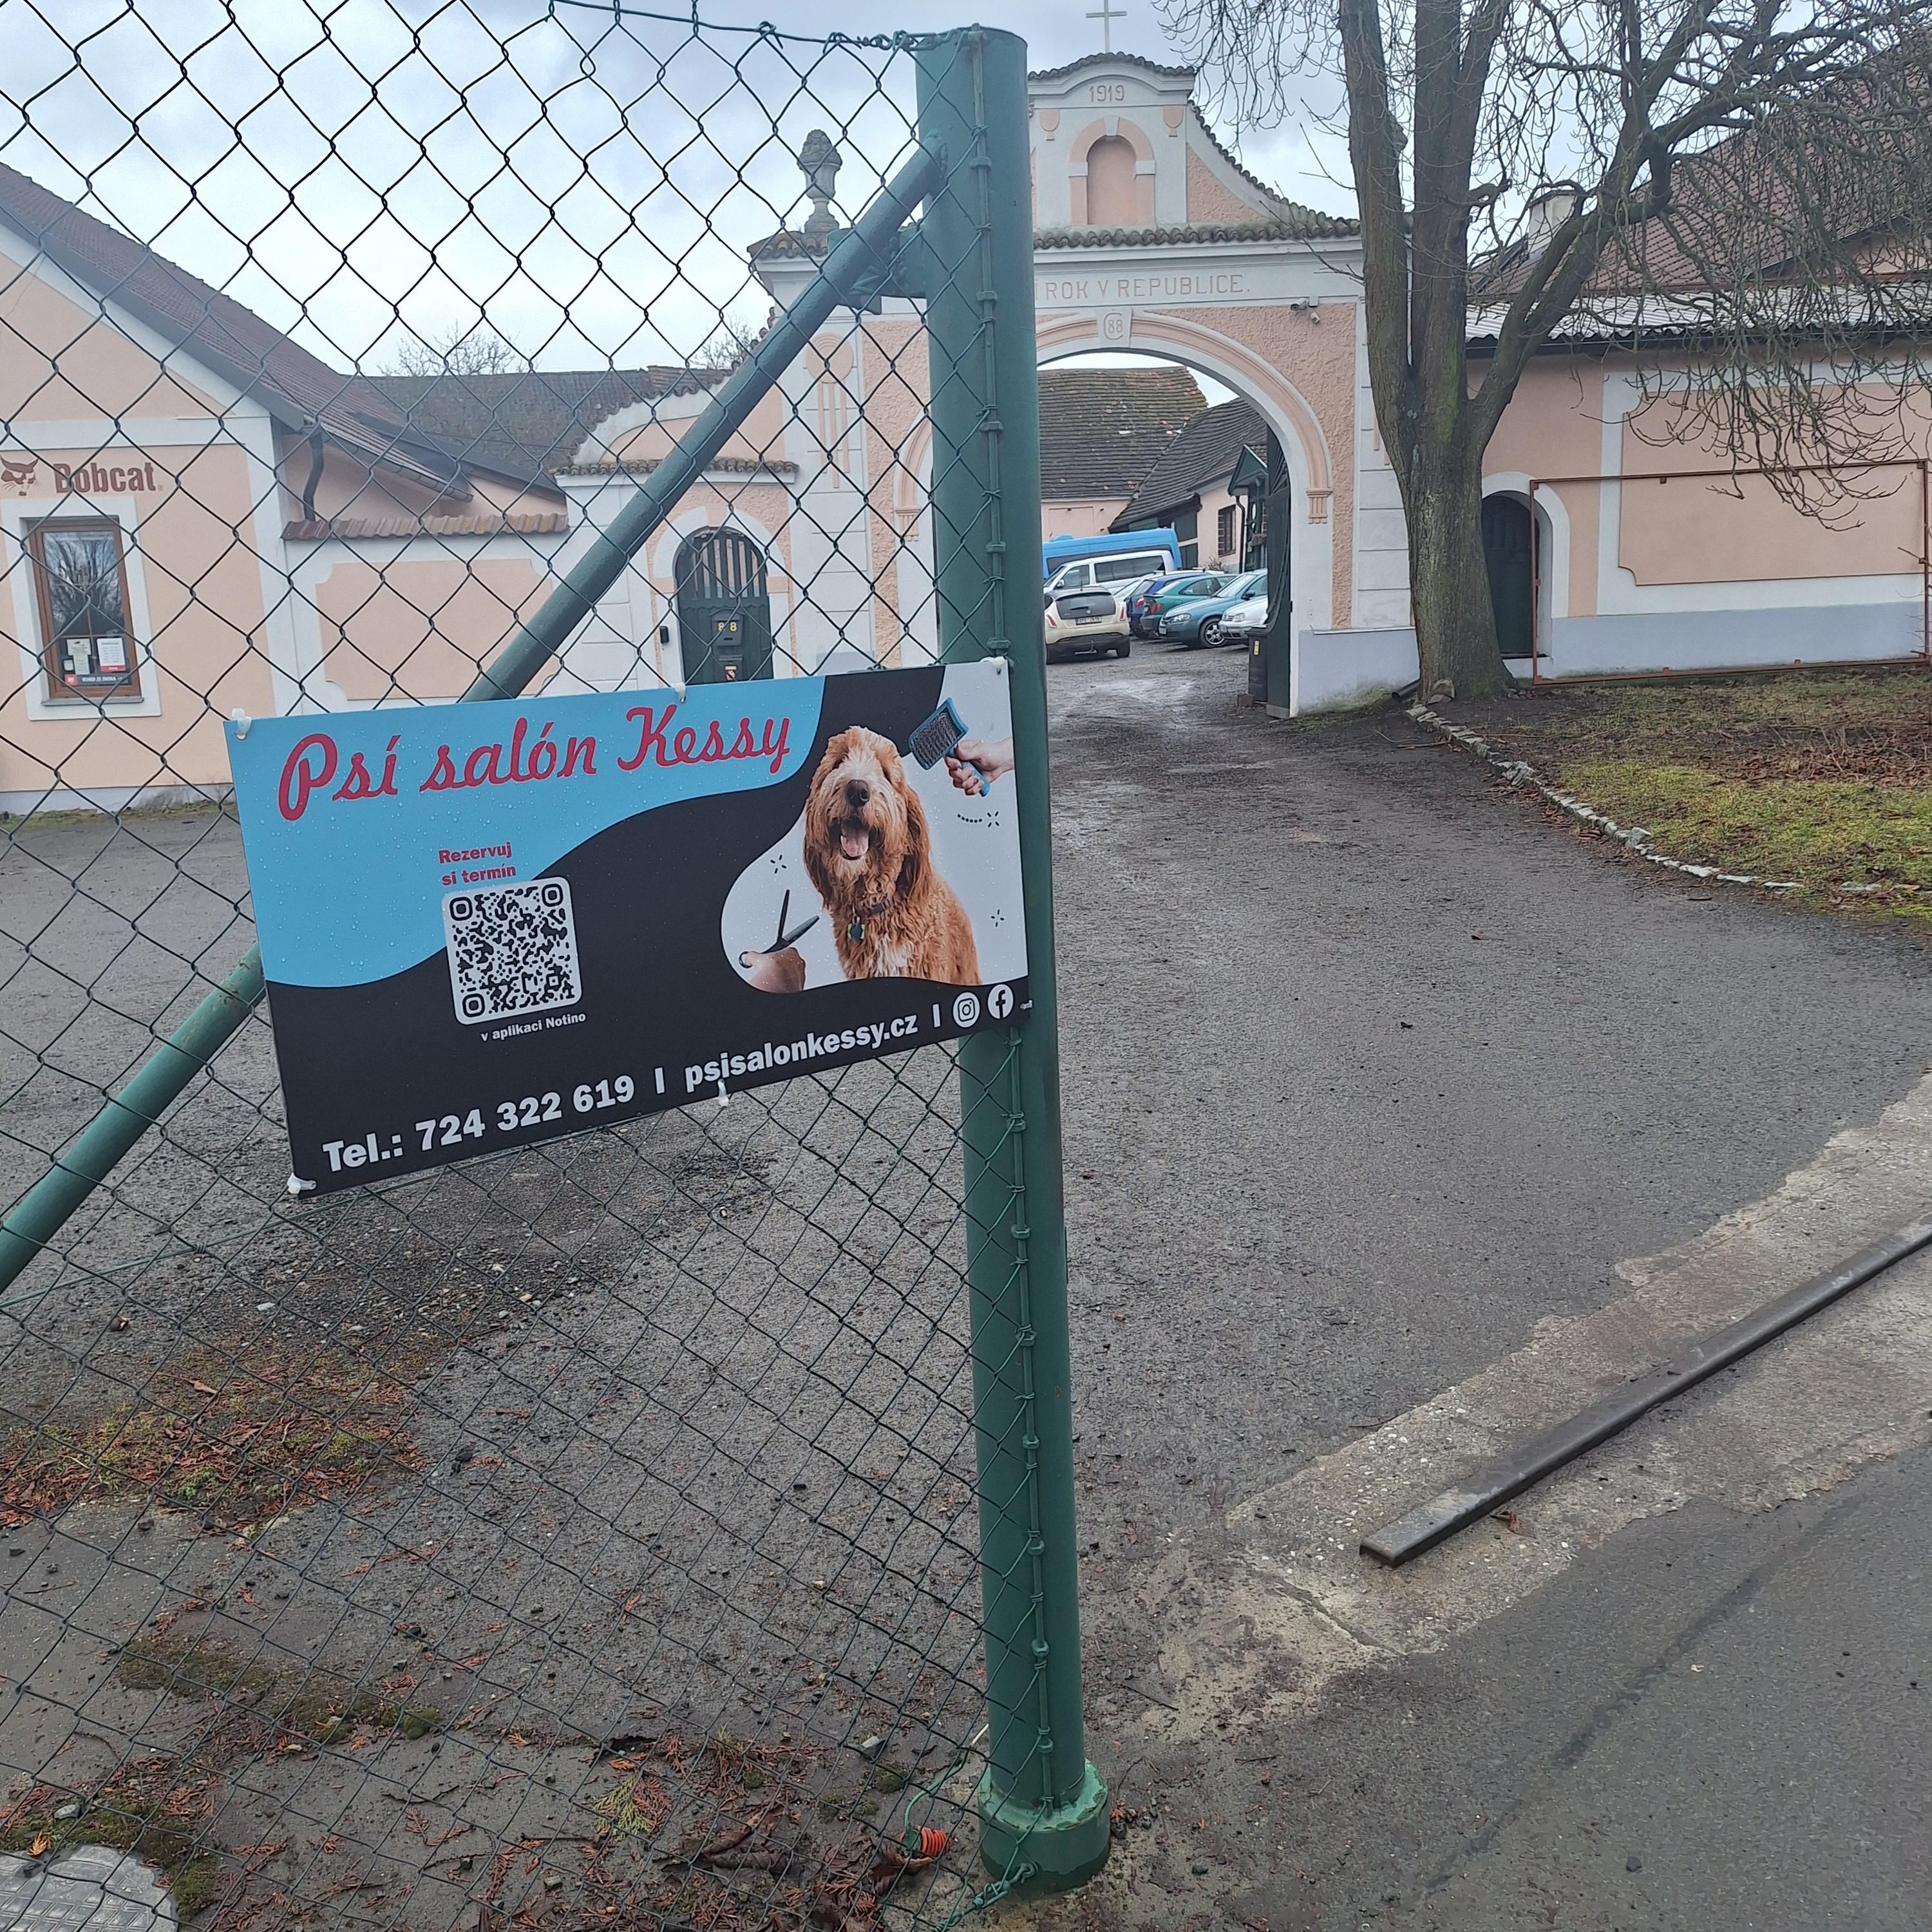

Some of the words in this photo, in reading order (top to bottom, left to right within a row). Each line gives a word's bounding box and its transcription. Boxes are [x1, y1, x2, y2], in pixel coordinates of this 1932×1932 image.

[1089, 84, 1124, 102] 1919
[1045, 281, 1088, 301] ROK
[1097, 279, 1108, 297] V
[1117, 274, 1251, 298] REPUBLICE.
[53, 462, 156, 493] Bobcat
[717, 621, 737, 632] 88
[278, 732, 402, 822] Psí
[419, 716, 597, 793] salón
[617, 703, 790, 775] Kessy
[438, 842, 513, 864] Rezervuj
[441, 870, 457, 886] si
[461, 863, 516, 883] termín
[480, 1033, 489, 1042] v
[492, 1019, 542, 1041] aplikaci
[545, 1012, 587, 1030] Notino
[322, 1132, 404, 1172] Tel.:
[415, 1108, 486, 1151] 724
[496, 1092, 563, 1132] 322
[573, 1074, 635, 1113] 619
[685, 1014, 918, 1094] psisalonkessy.cz
